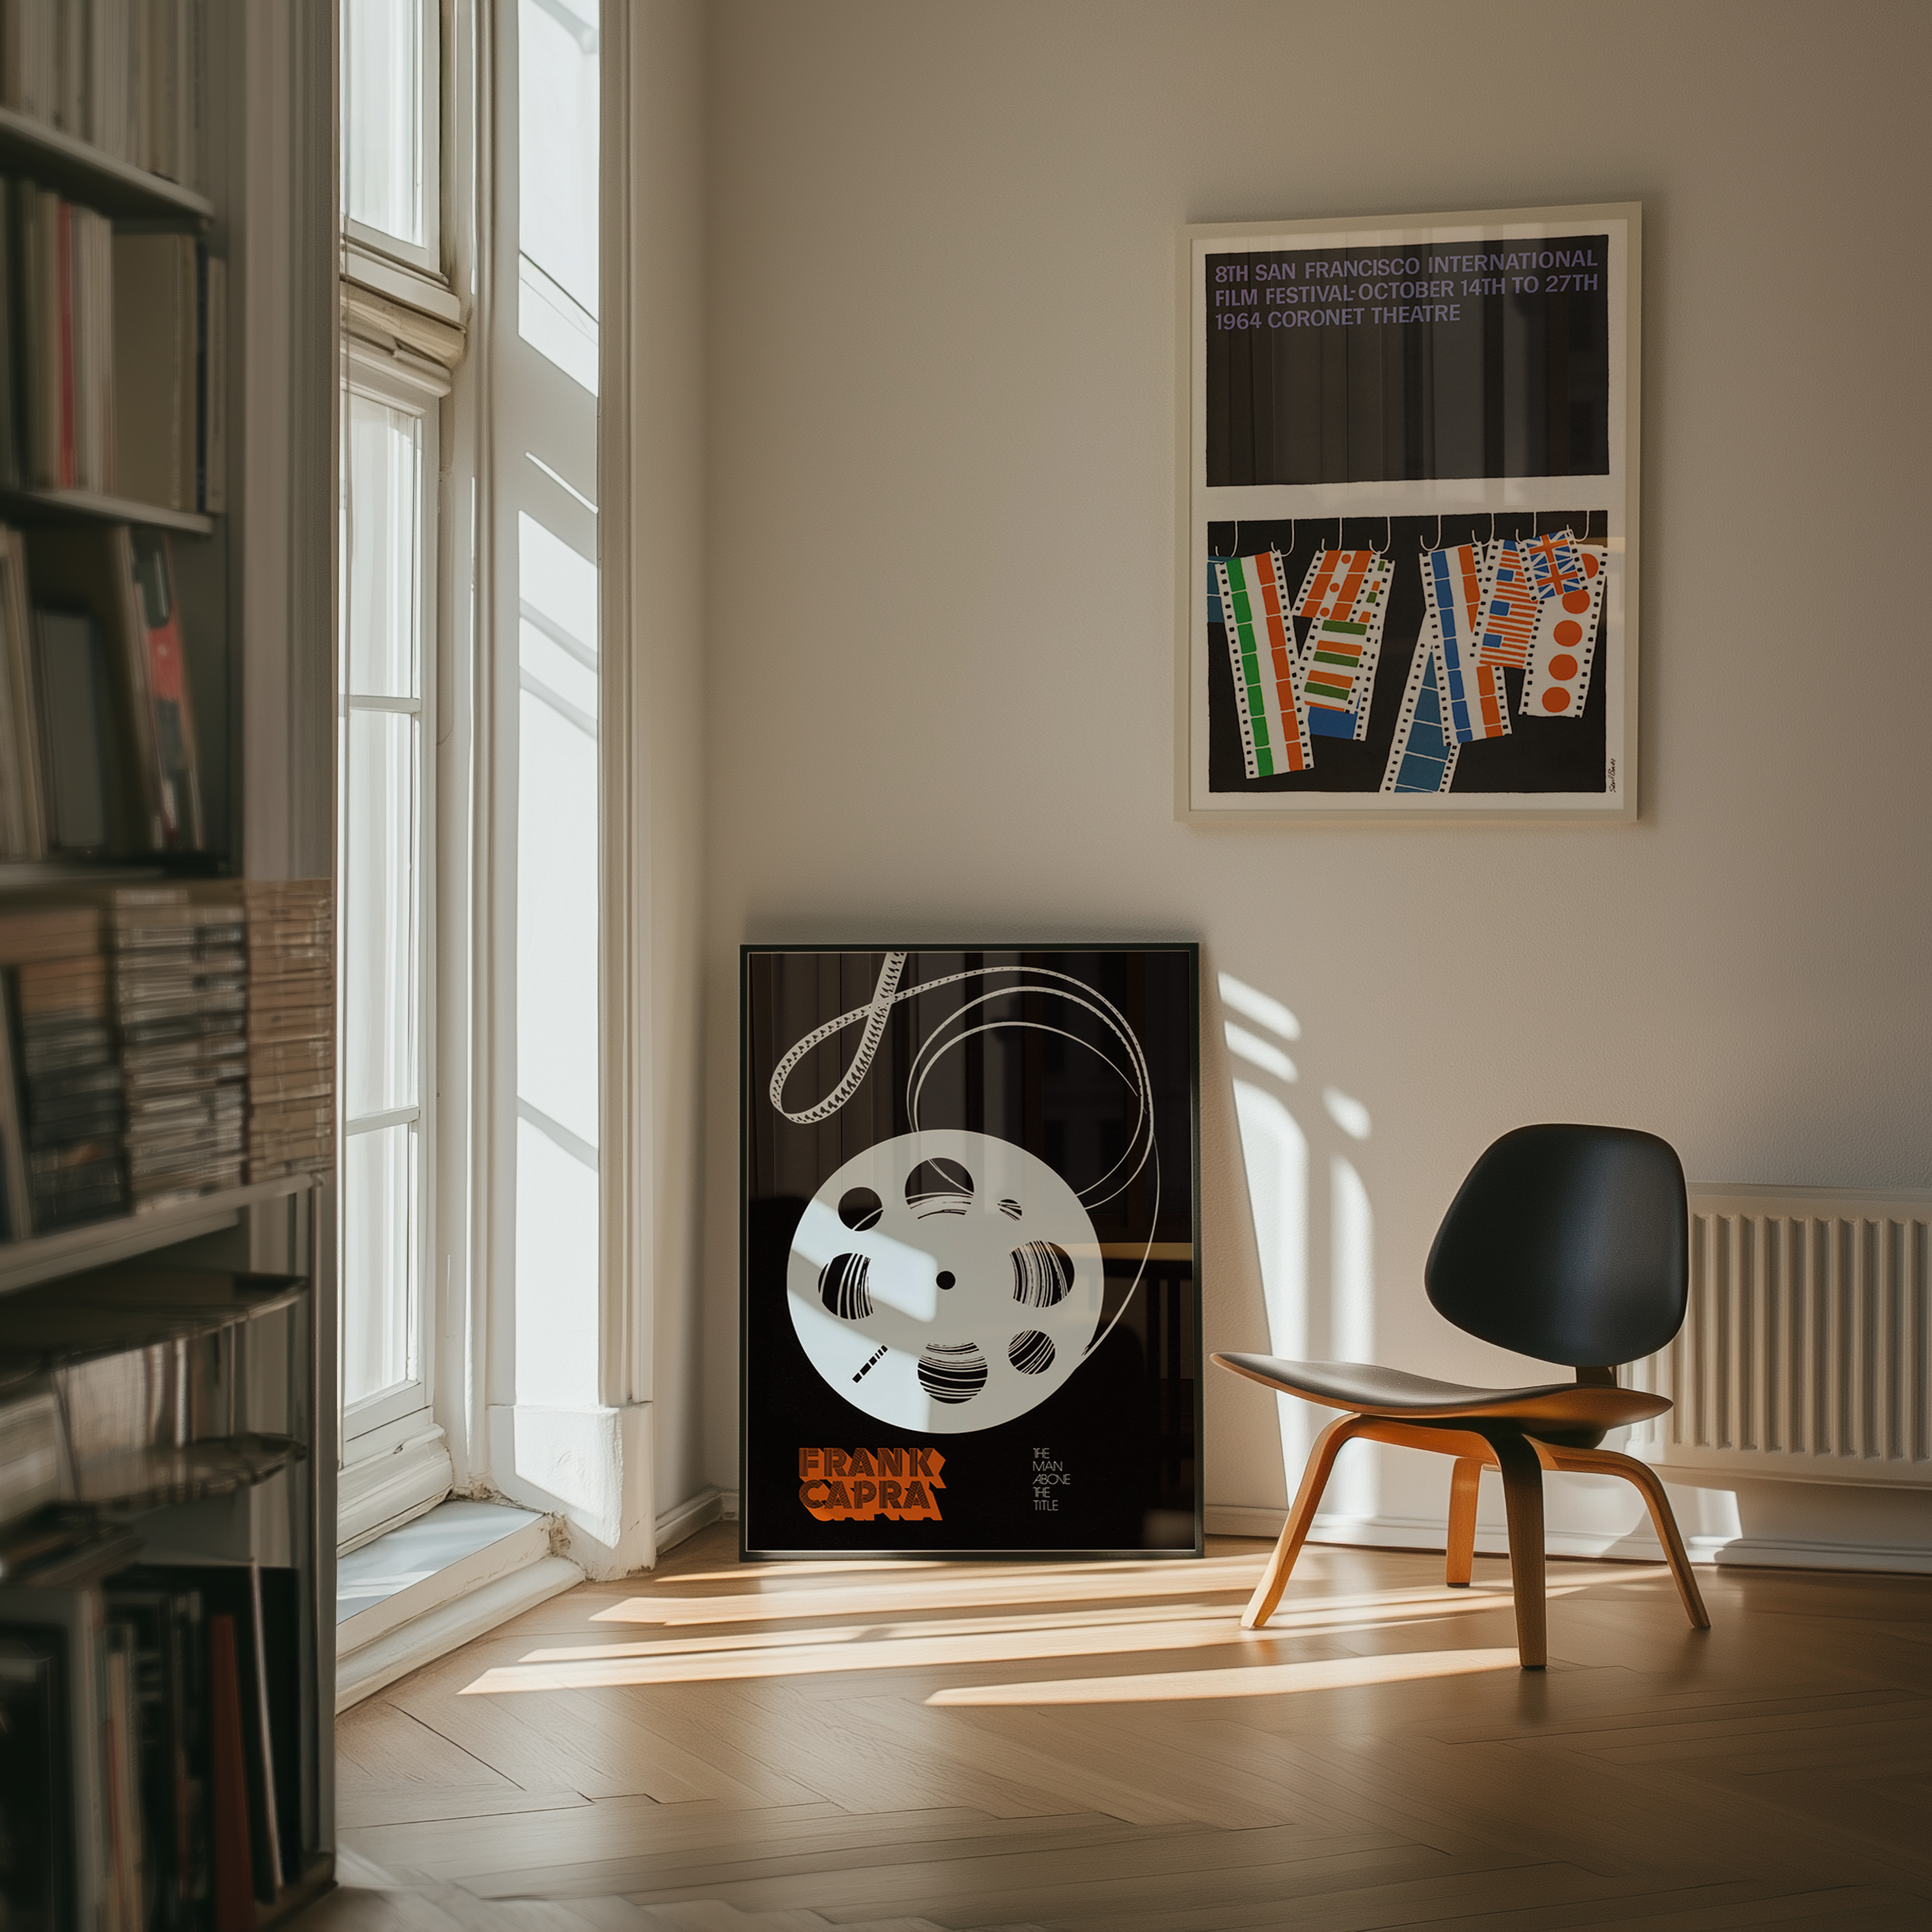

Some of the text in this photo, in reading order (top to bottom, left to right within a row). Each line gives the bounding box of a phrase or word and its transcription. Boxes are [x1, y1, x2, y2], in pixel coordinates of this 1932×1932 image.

[1215, 250, 1598, 283] 8TH SAN FRANCISCO INTERNATIONAL
[1215, 289, 1258, 307] FILM
[1461, 278, 1506, 296] 14TH
[1512, 276, 1539, 294] TO
[1545, 274, 1598, 292] 27TH
[1215, 304, 1461, 330] 1964 CORONET THEATRE
[799, 1448, 945, 1482] FRANK
[1032, 1448, 1050, 1459] THE
[1032, 1461, 1063, 1472] MAN
[799, 1479, 943, 1521] CAPRA
[1032, 1486, 1050, 1498] THE
[1032, 1500, 1059, 1511] TITLE
